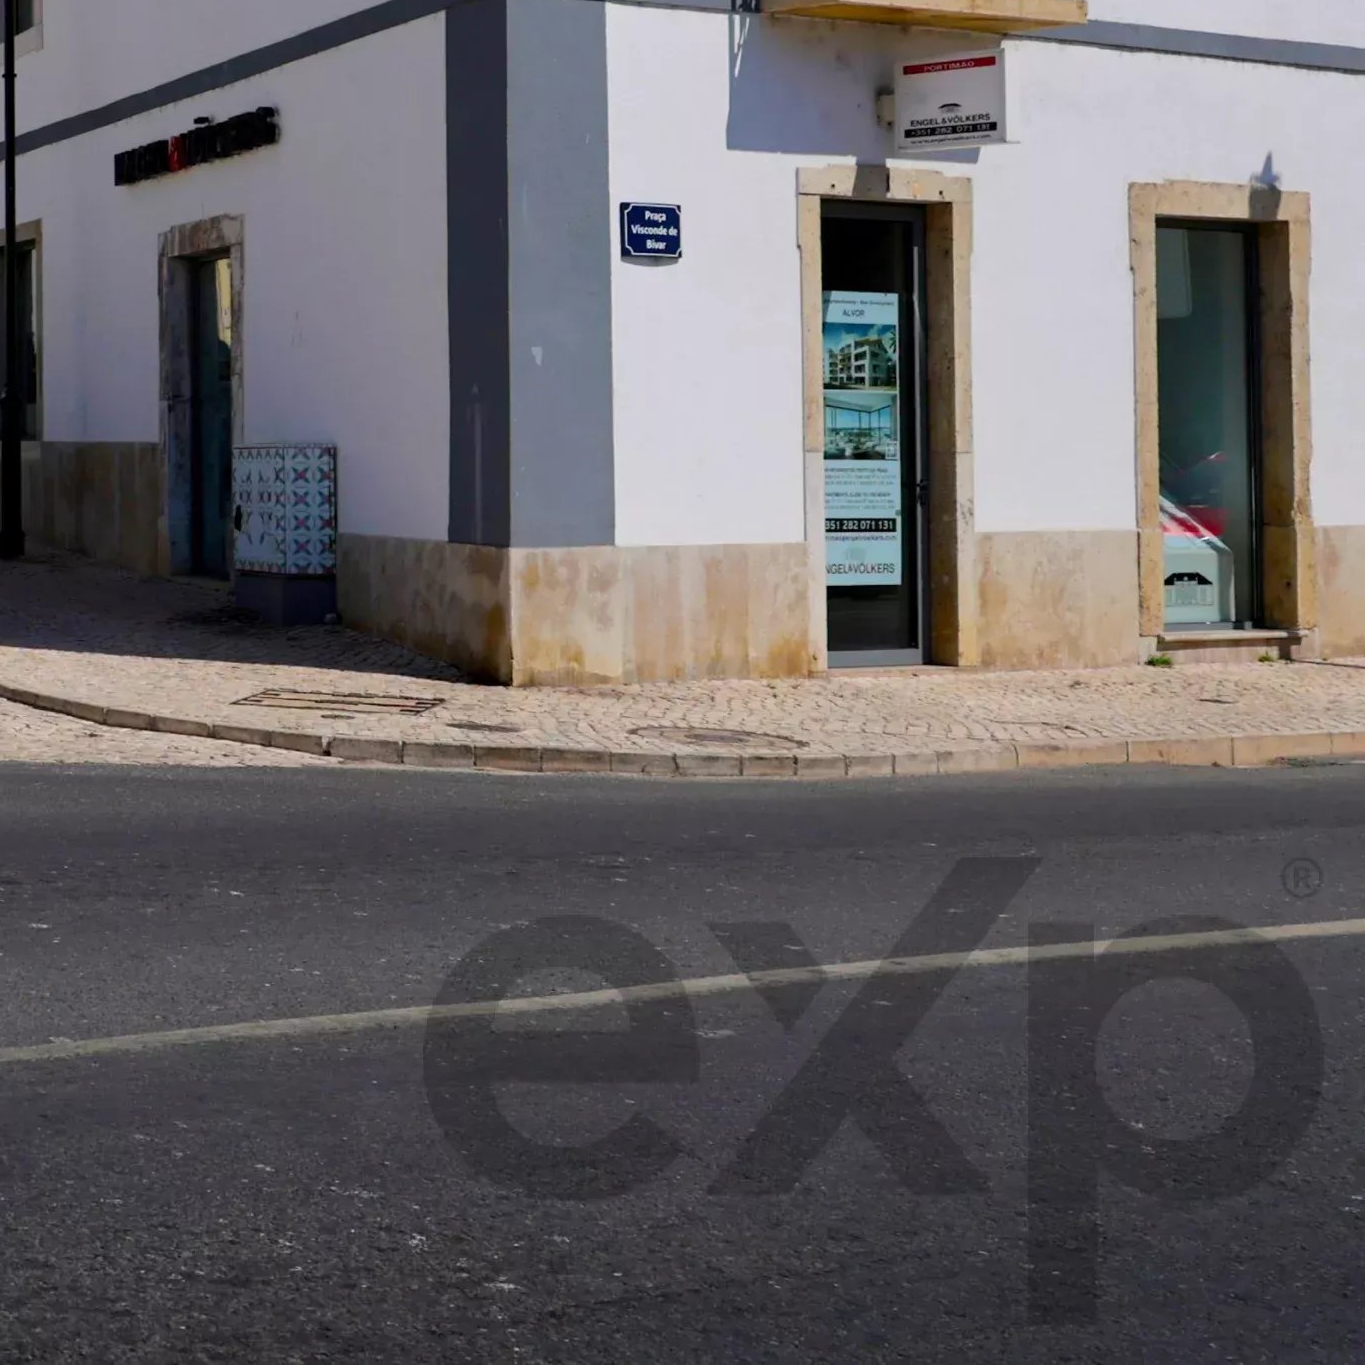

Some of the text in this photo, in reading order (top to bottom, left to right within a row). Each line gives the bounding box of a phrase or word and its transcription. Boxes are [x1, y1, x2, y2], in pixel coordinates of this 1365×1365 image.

[956, 125, 972, 133] 071
[645, 210, 666, 223] Praça
[631, 224, 678, 236] Visconde de
[646, 239, 666, 249] Bivar
[842, 520, 859, 530] 282
[860, 520, 876, 530] 071
[878, 520, 893, 530] 131
